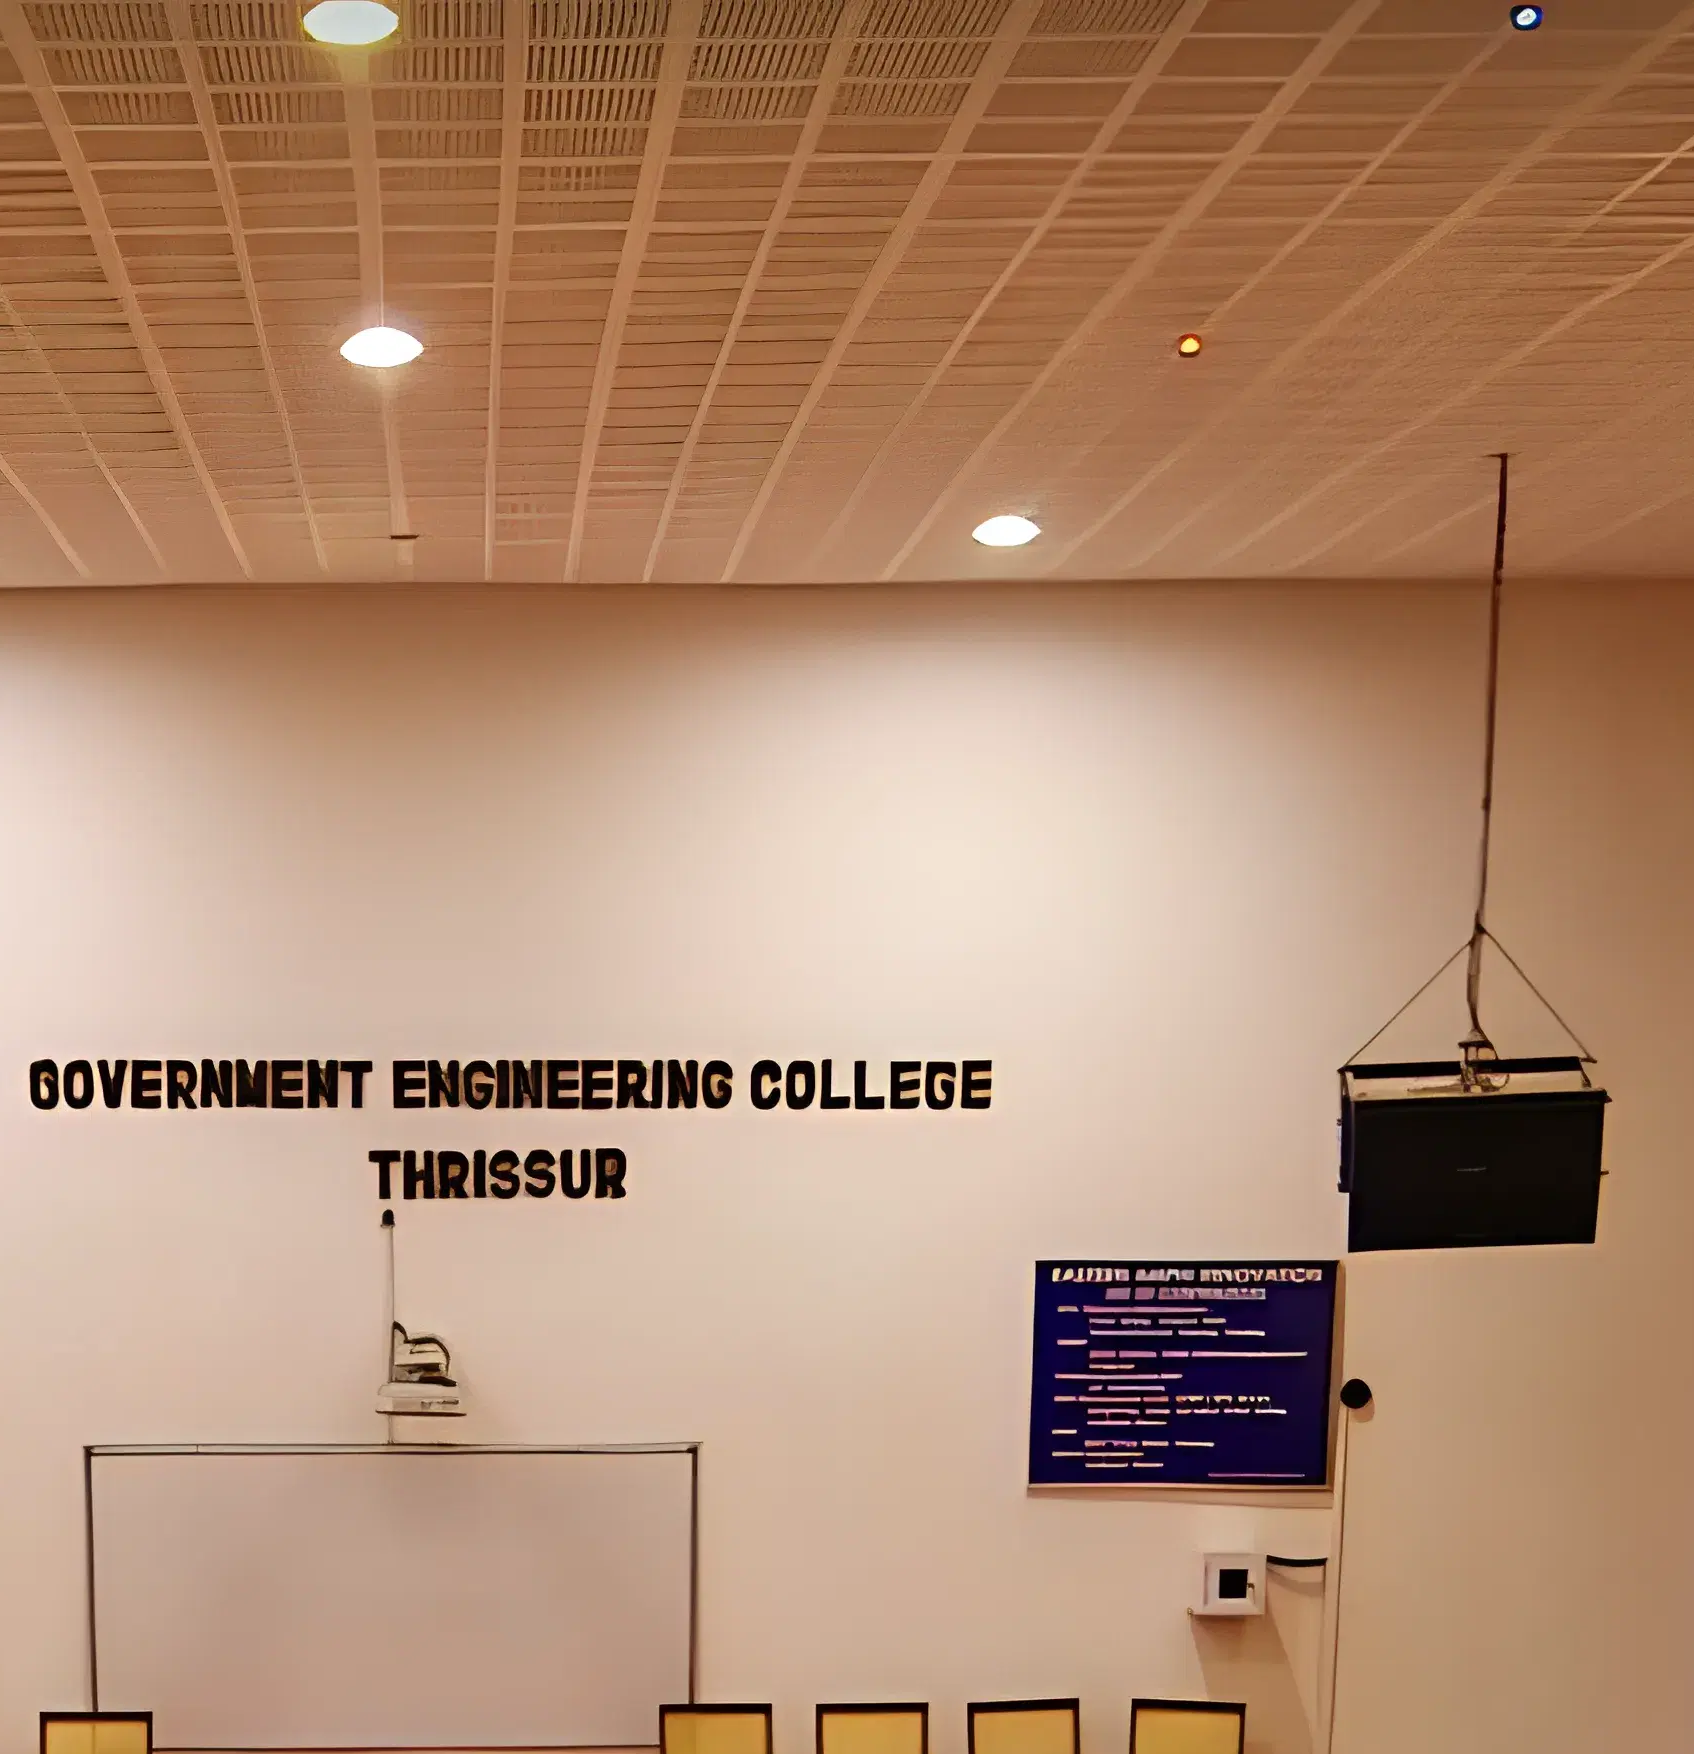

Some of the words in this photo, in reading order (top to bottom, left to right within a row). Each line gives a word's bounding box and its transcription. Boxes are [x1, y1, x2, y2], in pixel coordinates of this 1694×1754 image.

[29, 1058, 373, 1110] GOVERNMENT
[392, 1059, 734, 1110] ENGINEERING
[750, 1058, 993, 1111] COLLEGE
[368, 1147, 627, 1200] THRISSUR
